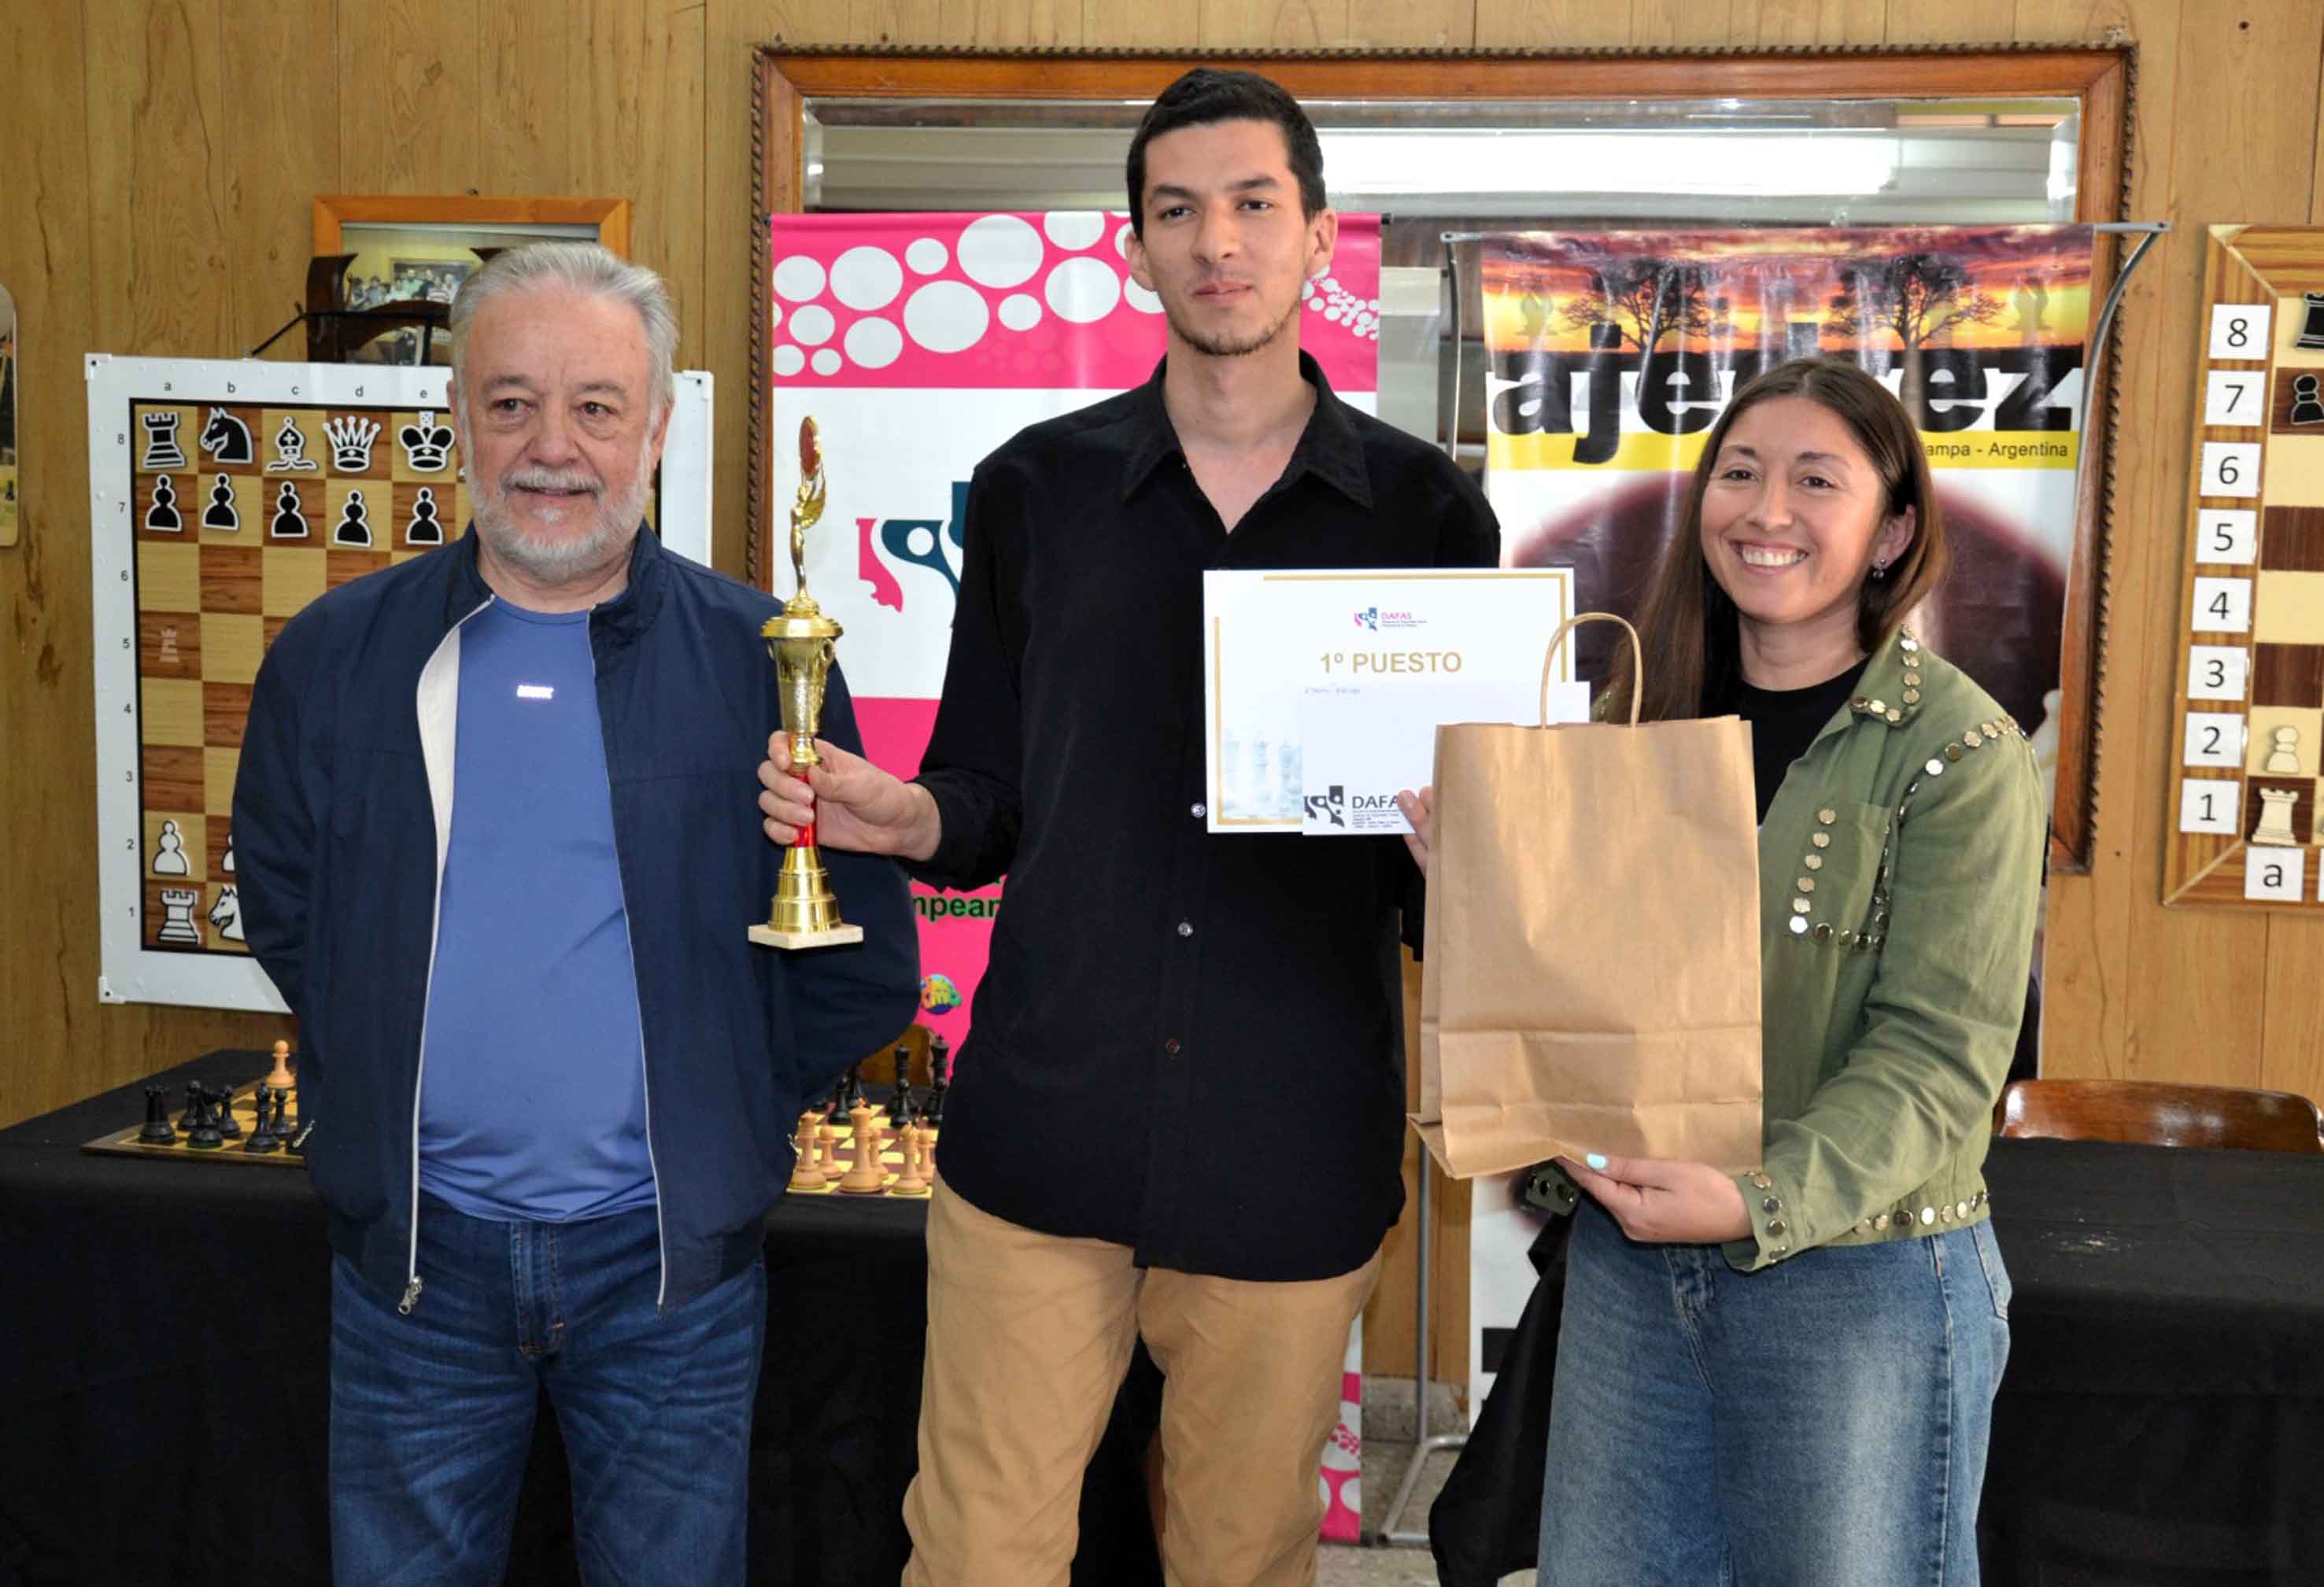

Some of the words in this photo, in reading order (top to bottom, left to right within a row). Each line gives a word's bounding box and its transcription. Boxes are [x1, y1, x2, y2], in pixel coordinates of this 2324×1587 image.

[2227, 318, 2248, 348] 8
[164, 382, 172, 391] a
[227, 382, 236, 393] b
[290, 386, 299, 396] c
[355, 386, 364, 397] d
[419, 389, 428, 399] e
[1492, 322, 2079, 465] ajeez
[2225, 384, 2245, 413] 7
[116, 433, 125, 445] 8
[1927, 444, 1971, 459] ampa
[1987, 441, 2068, 460] Argentina
[2219, 456, 2239, 485] 6
[118, 501, 126, 513] 7
[2214, 522, 2233, 552] 5
[120, 570, 129, 581] 6
[2209, 591, 2230, 620] 4
[122, 637, 131, 649] 5
[1352, 651, 1462, 674] PUESTO
[2205, 659, 2225, 688] 3
[124, 703, 132, 714] 4
[2201, 726, 2220, 755] 2
[125, 770, 133, 783] 3
[1351, 795, 1399, 810] DAFA
[2200, 793, 2216, 821] 1
[127, 838, 135, 851] 2
[2263, 864, 2283, 888] a
[128, 906, 135, 917] 1
